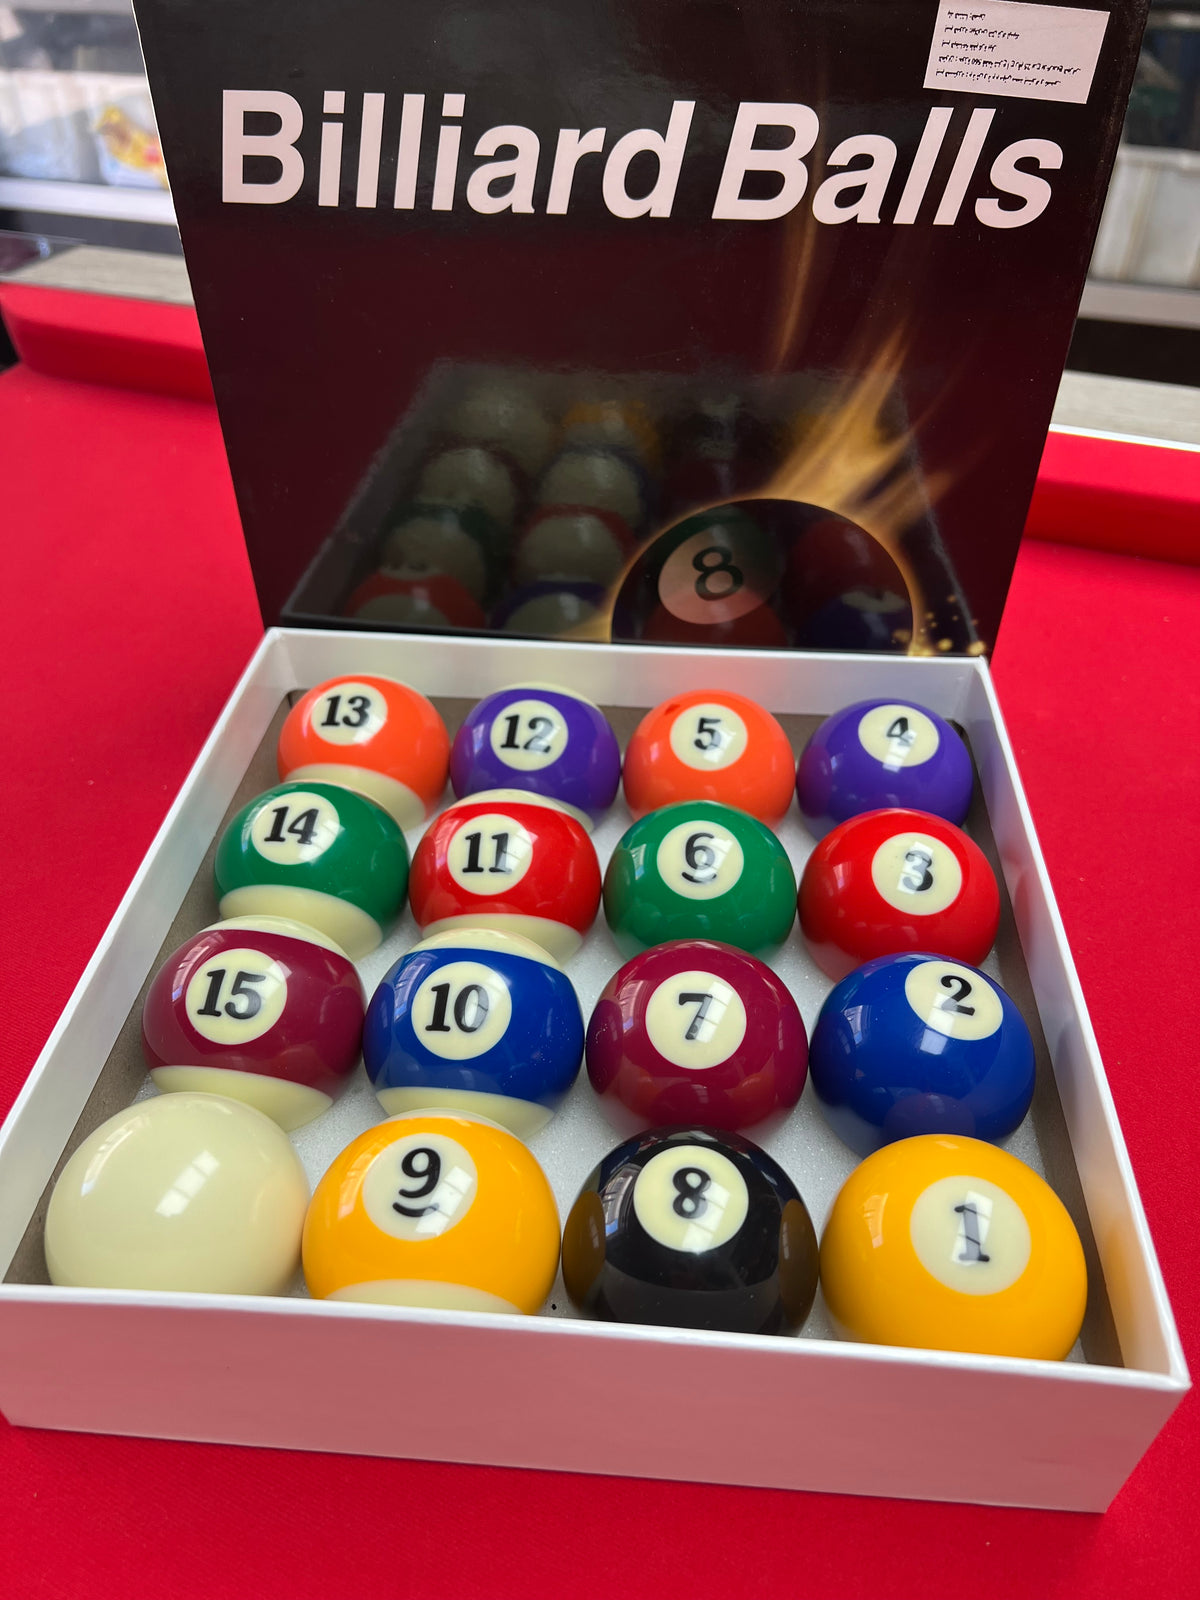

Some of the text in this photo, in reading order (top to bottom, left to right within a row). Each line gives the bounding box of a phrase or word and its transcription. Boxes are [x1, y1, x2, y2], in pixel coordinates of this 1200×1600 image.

[222, 89, 1064, 229] Billiard Balls
[692, 545, 744, 602] 8
[320, 694, 371, 728] 13
[499, 714, 551, 754] 12
[693, 715, 721, 751] 5
[886, 715, 912, 747] 4
[263, 805, 319, 846] 14
[461, 831, 512, 875] 11
[681, 831, 717, 884] 6
[903, 850, 934, 893] 3
[196, 968, 262, 1021] 15
[424, 982, 488, 1034] 10
[677, 992, 714, 1041] 7
[940, 974, 976, 1017] 2
[392, 1147, 442, 1219] 9
[672, 1166, 712, 1220] 8
[957, 1203, 992, 1265] 1
